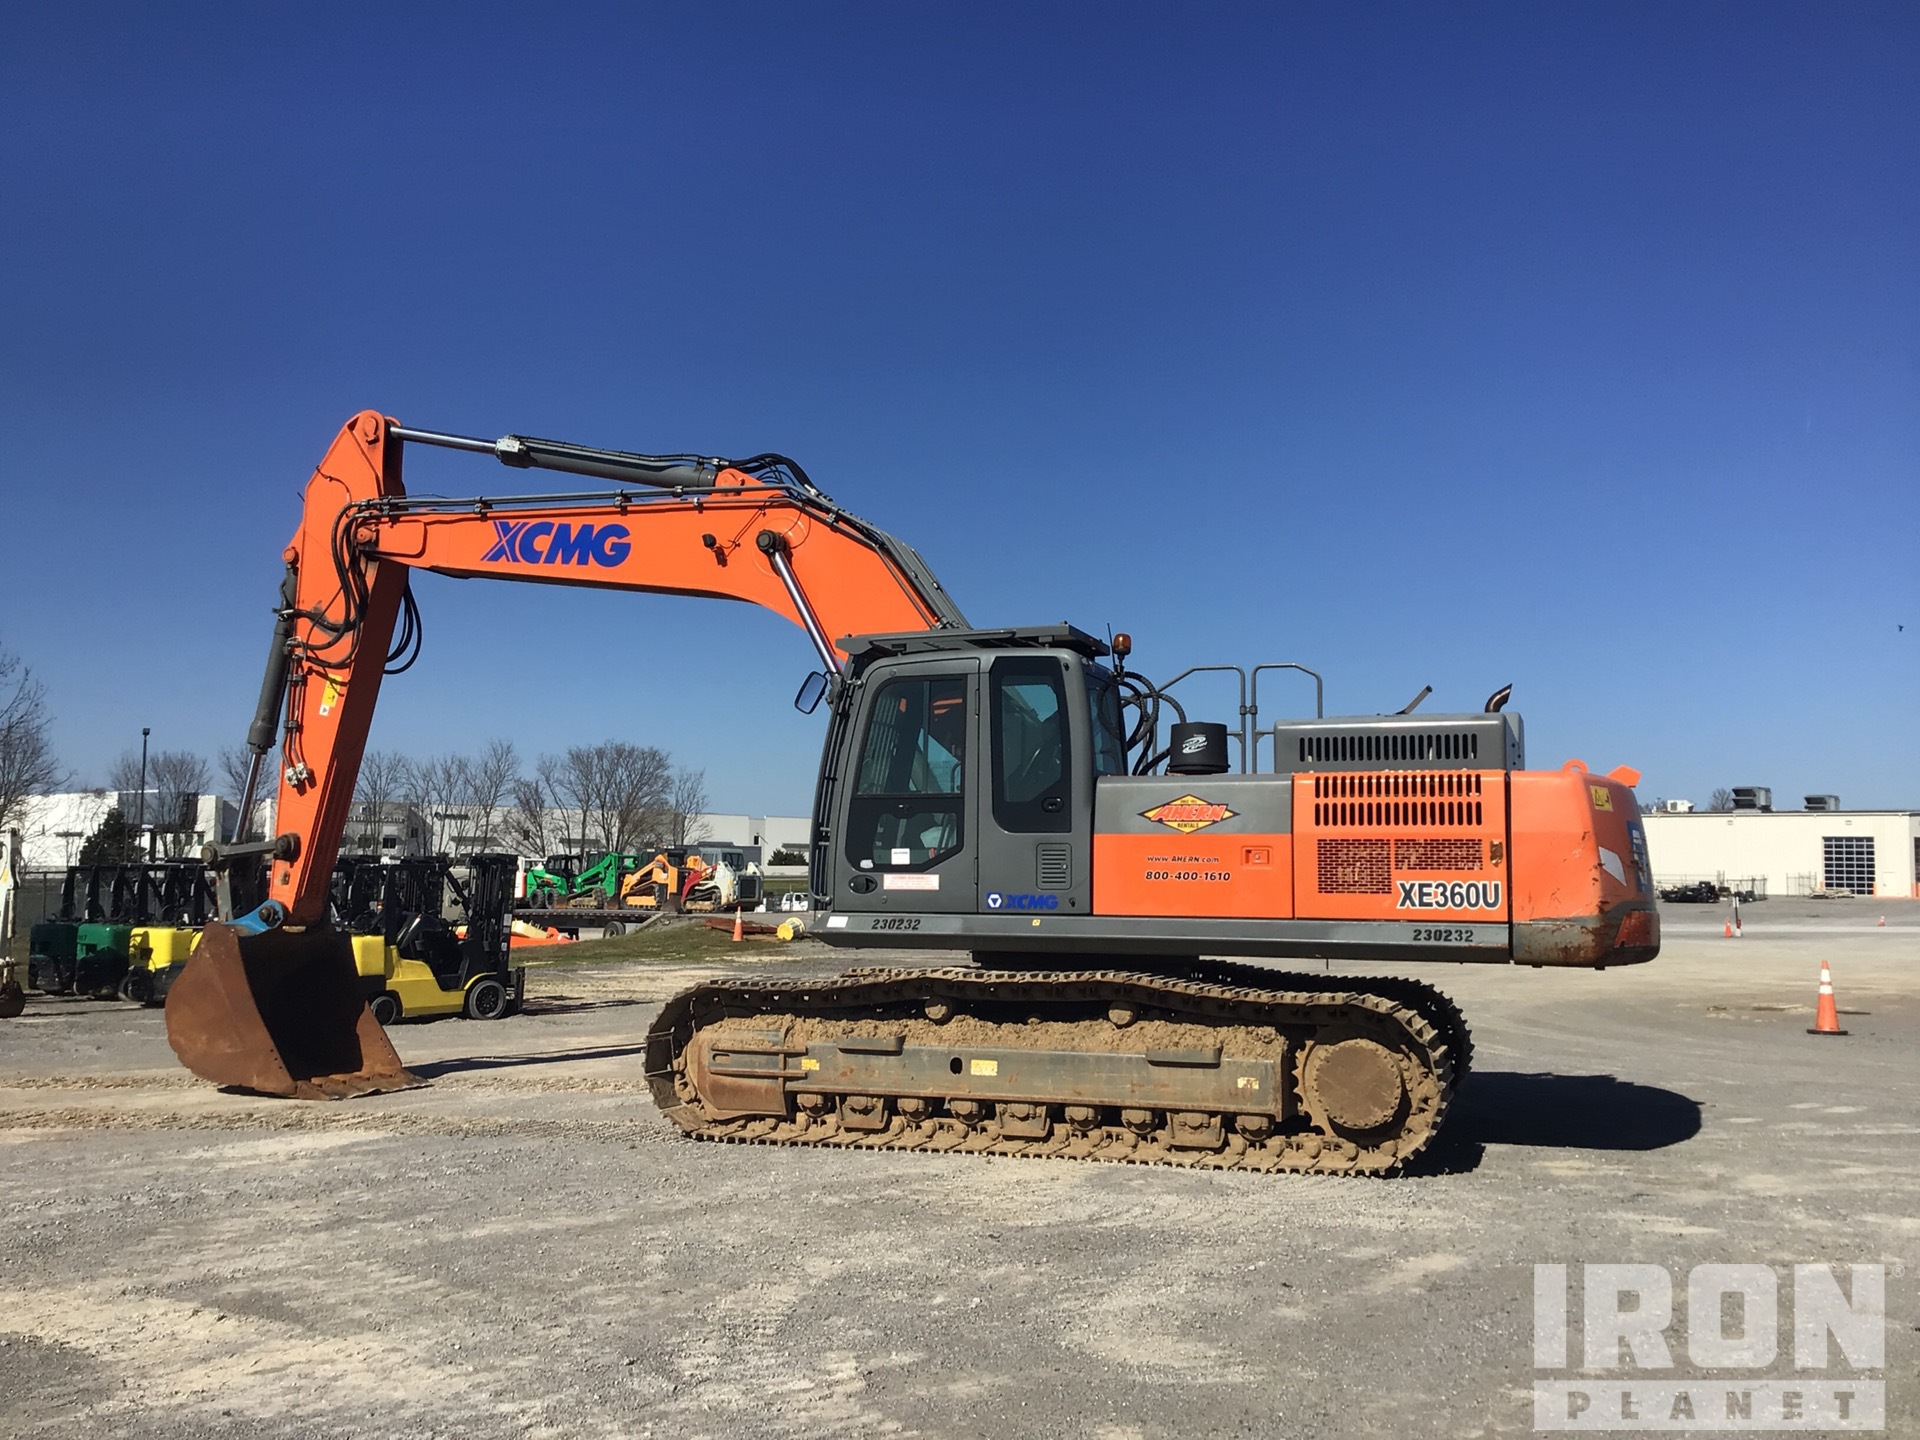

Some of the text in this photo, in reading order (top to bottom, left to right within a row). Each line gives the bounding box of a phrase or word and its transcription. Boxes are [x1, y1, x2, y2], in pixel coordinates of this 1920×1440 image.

[480, 519, 631, 567] XCMG
[1150, 804, 1228, 822] AHERN
[1145, 871, 1231, 881] 800-400-1610
[1004, 894, 1059, 910] XCMG
[1396, 881, 1502, 910] XE360U
[871, 918, 921, 931] 230232
[1412, 929, 1474, 942] 230232
